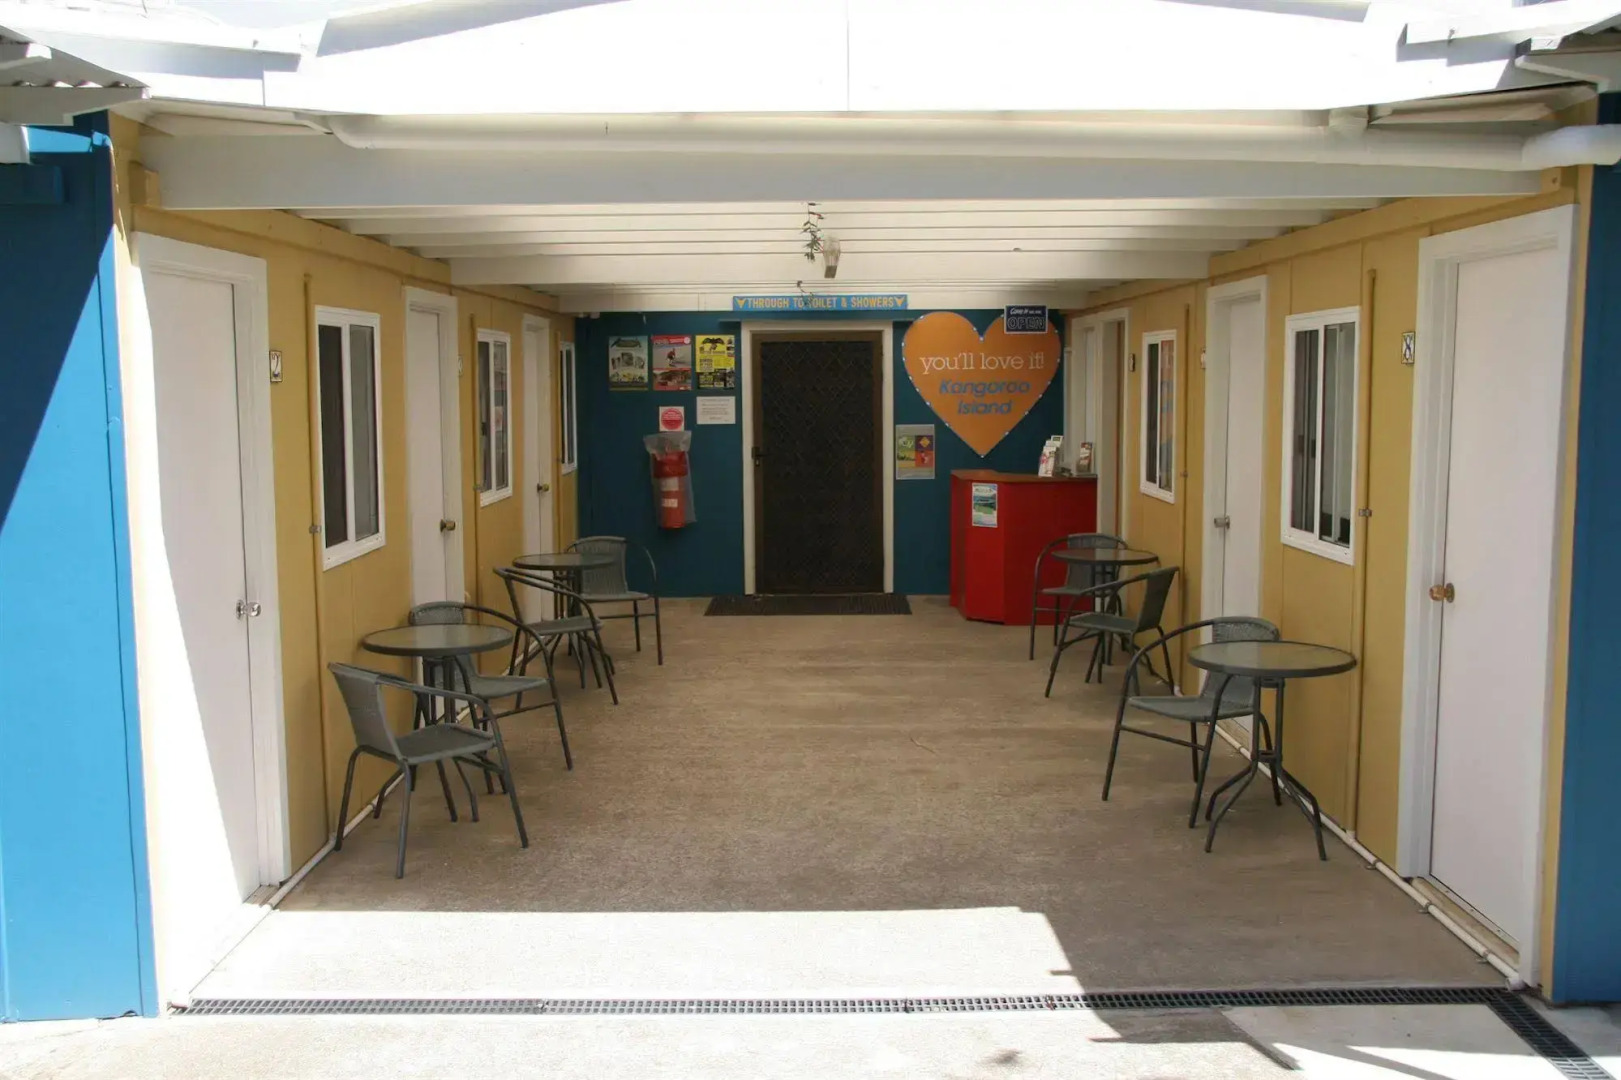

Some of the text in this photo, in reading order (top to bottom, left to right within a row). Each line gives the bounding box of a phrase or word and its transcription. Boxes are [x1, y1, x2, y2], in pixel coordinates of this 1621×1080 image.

[748, 297, 789, 309] THROUGH
[793, 297, 804, 308] TO
[840, 297, 848, 308] &
[851, 296, 894, 308] SHOWERS
[1007, 317, 1045, 330] OPEN
[920, 352, 1044, 375] you'll love it!
[957, 400, 1013, 415] Island
